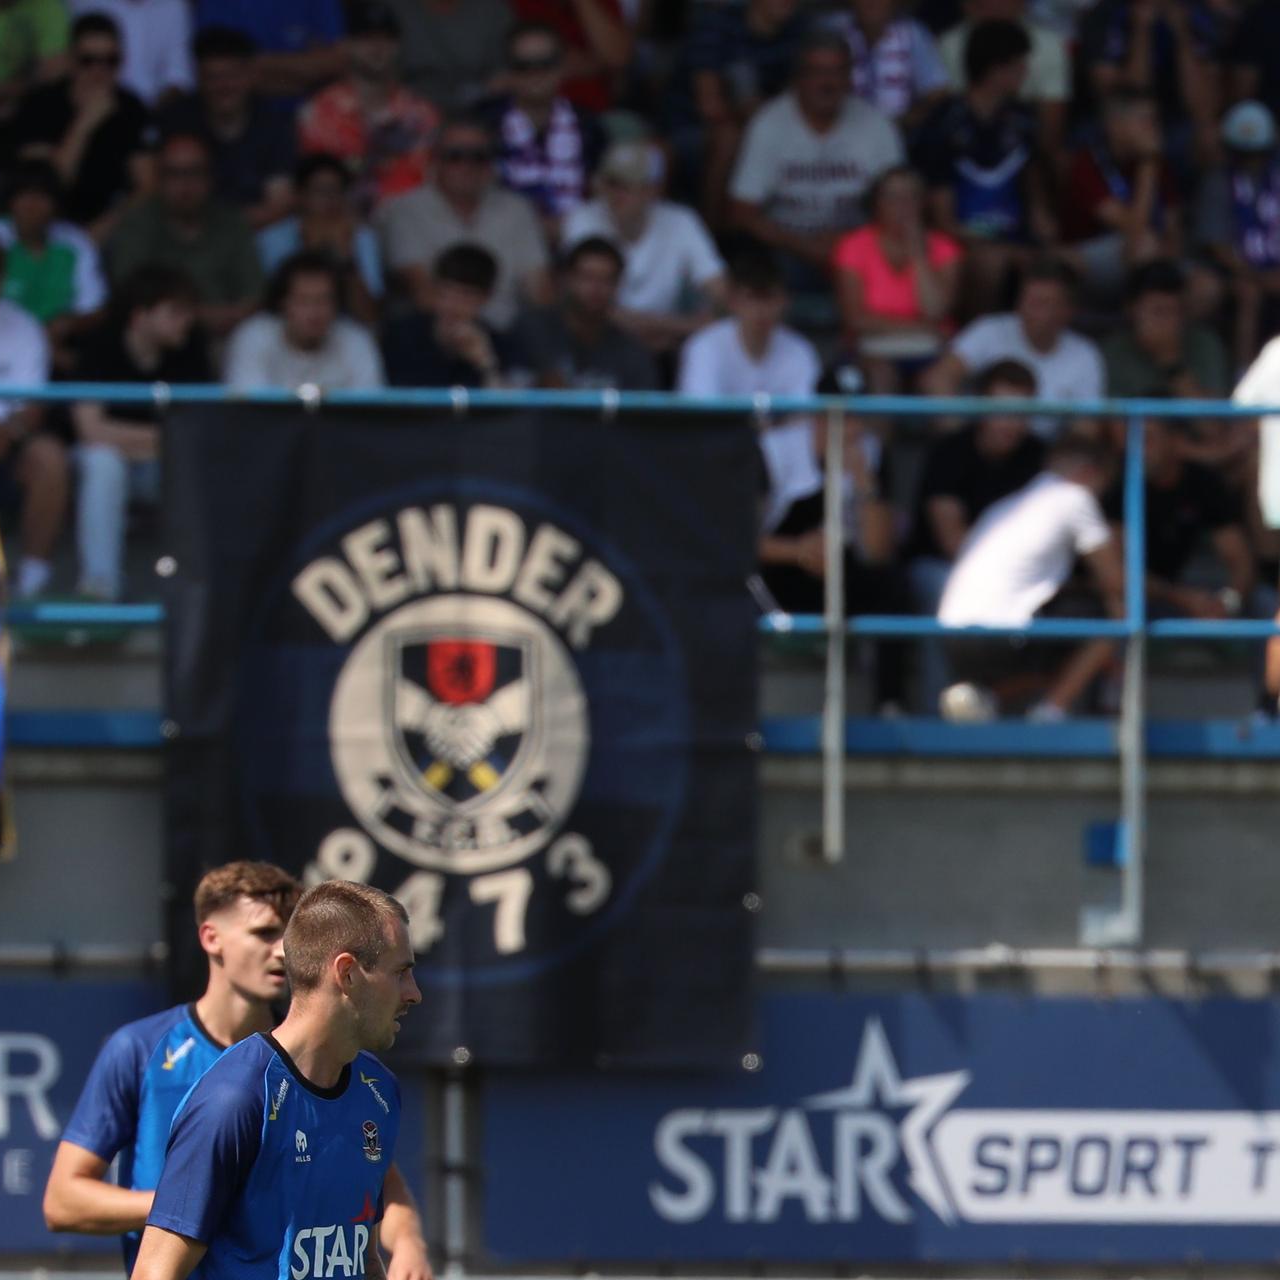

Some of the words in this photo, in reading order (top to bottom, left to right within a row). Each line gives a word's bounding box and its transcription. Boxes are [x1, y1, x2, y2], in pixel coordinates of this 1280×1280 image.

[291, 502, 623, 646] DENDER
[648, 1106, 916, 1225] STAR
[970, 1133, 1210, 1198] SPORT
[290, 1224, 369, 1280] STAR
